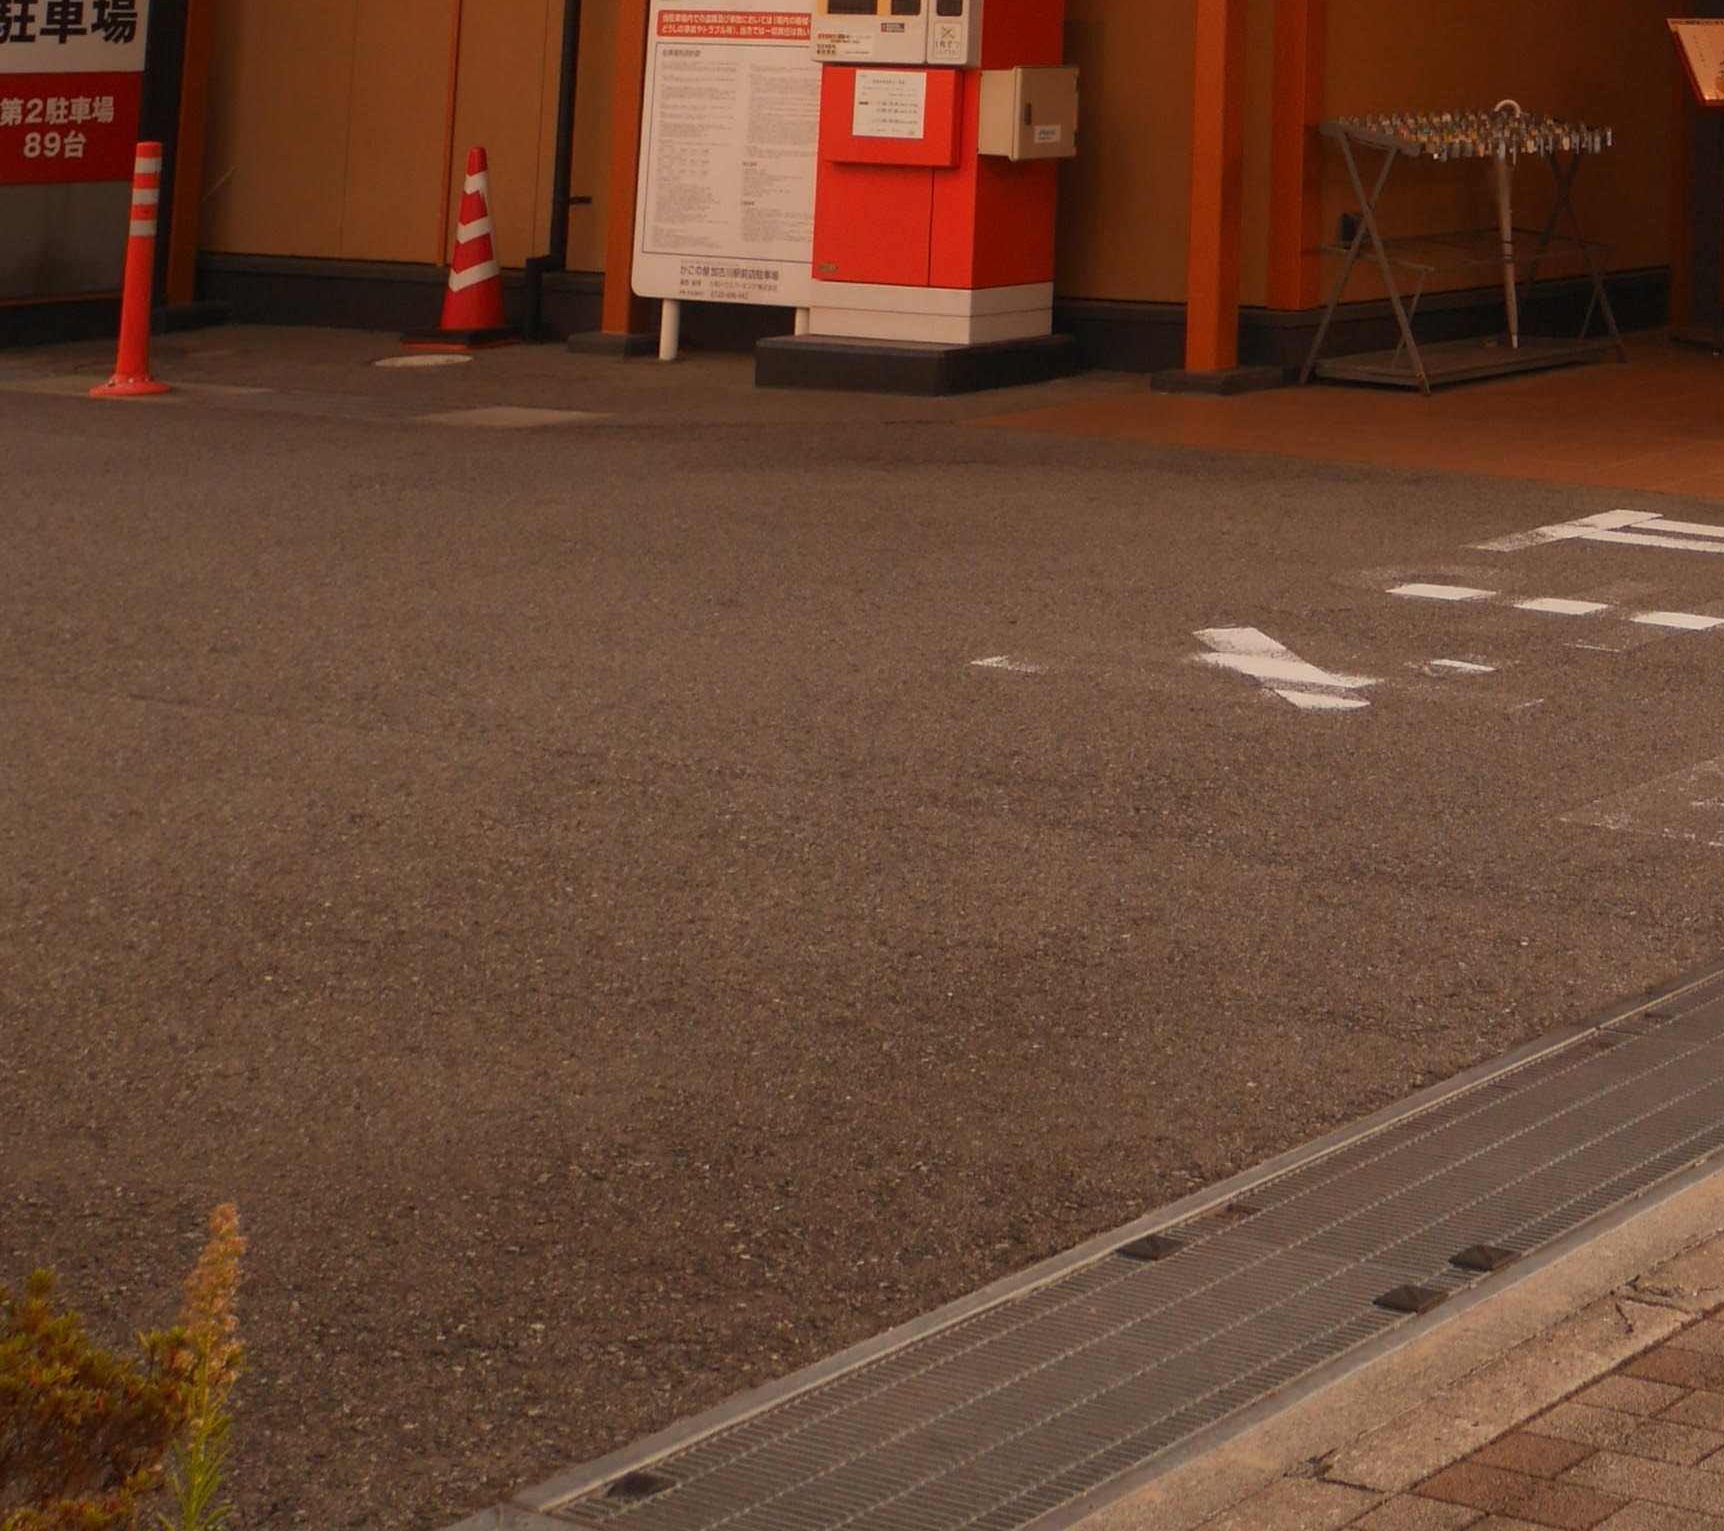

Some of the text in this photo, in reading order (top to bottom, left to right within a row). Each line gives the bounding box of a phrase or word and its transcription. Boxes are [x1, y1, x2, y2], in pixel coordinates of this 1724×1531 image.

[0, 95, 115, 126] 第2駐車場
[23, 130, 86, 159] 89台
